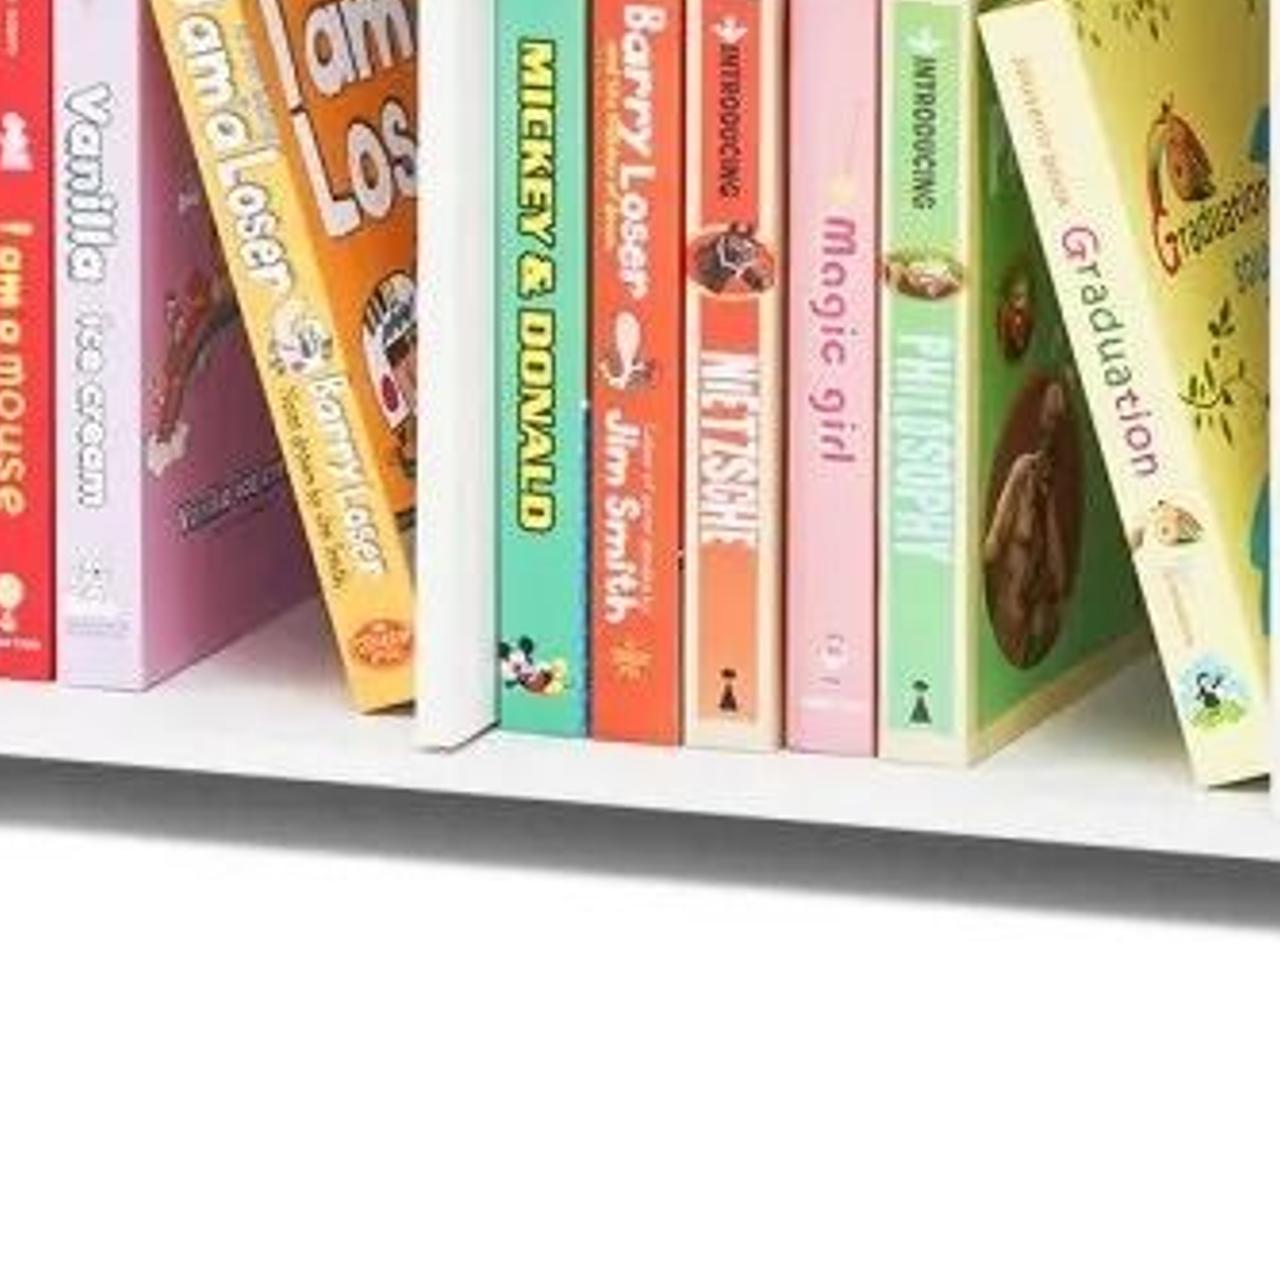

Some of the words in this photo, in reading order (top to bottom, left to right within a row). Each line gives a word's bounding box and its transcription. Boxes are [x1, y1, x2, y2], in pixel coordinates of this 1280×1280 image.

[178, 13, 234, 105] am
[220, 144, 292, 296] Loser
[518, 40, 555, 247] MICKEY
[620, 2, 668, 159] Barry
[718, 44, 741, 199] INTRODUCING
[911, 56, 938, 211] INTRODUCING
[65, 80, 118, 282] Vanilla
[619, 164, 657, 300] Loser
[517, 250, 555, 301] &
[1061, 223, 1162, 479] Graduation
[76, 382, 107, 509] cream
[518, 307, 555, 533] DONALD
[604, 406, 641, 488] Jim
[699, 350, 760, 550] NIETZSCHE
[808, 383, 857, 464] girl
[890, 333, 955, 562] PHILOSOPHY
[604, 492, 642, 625] Smith
